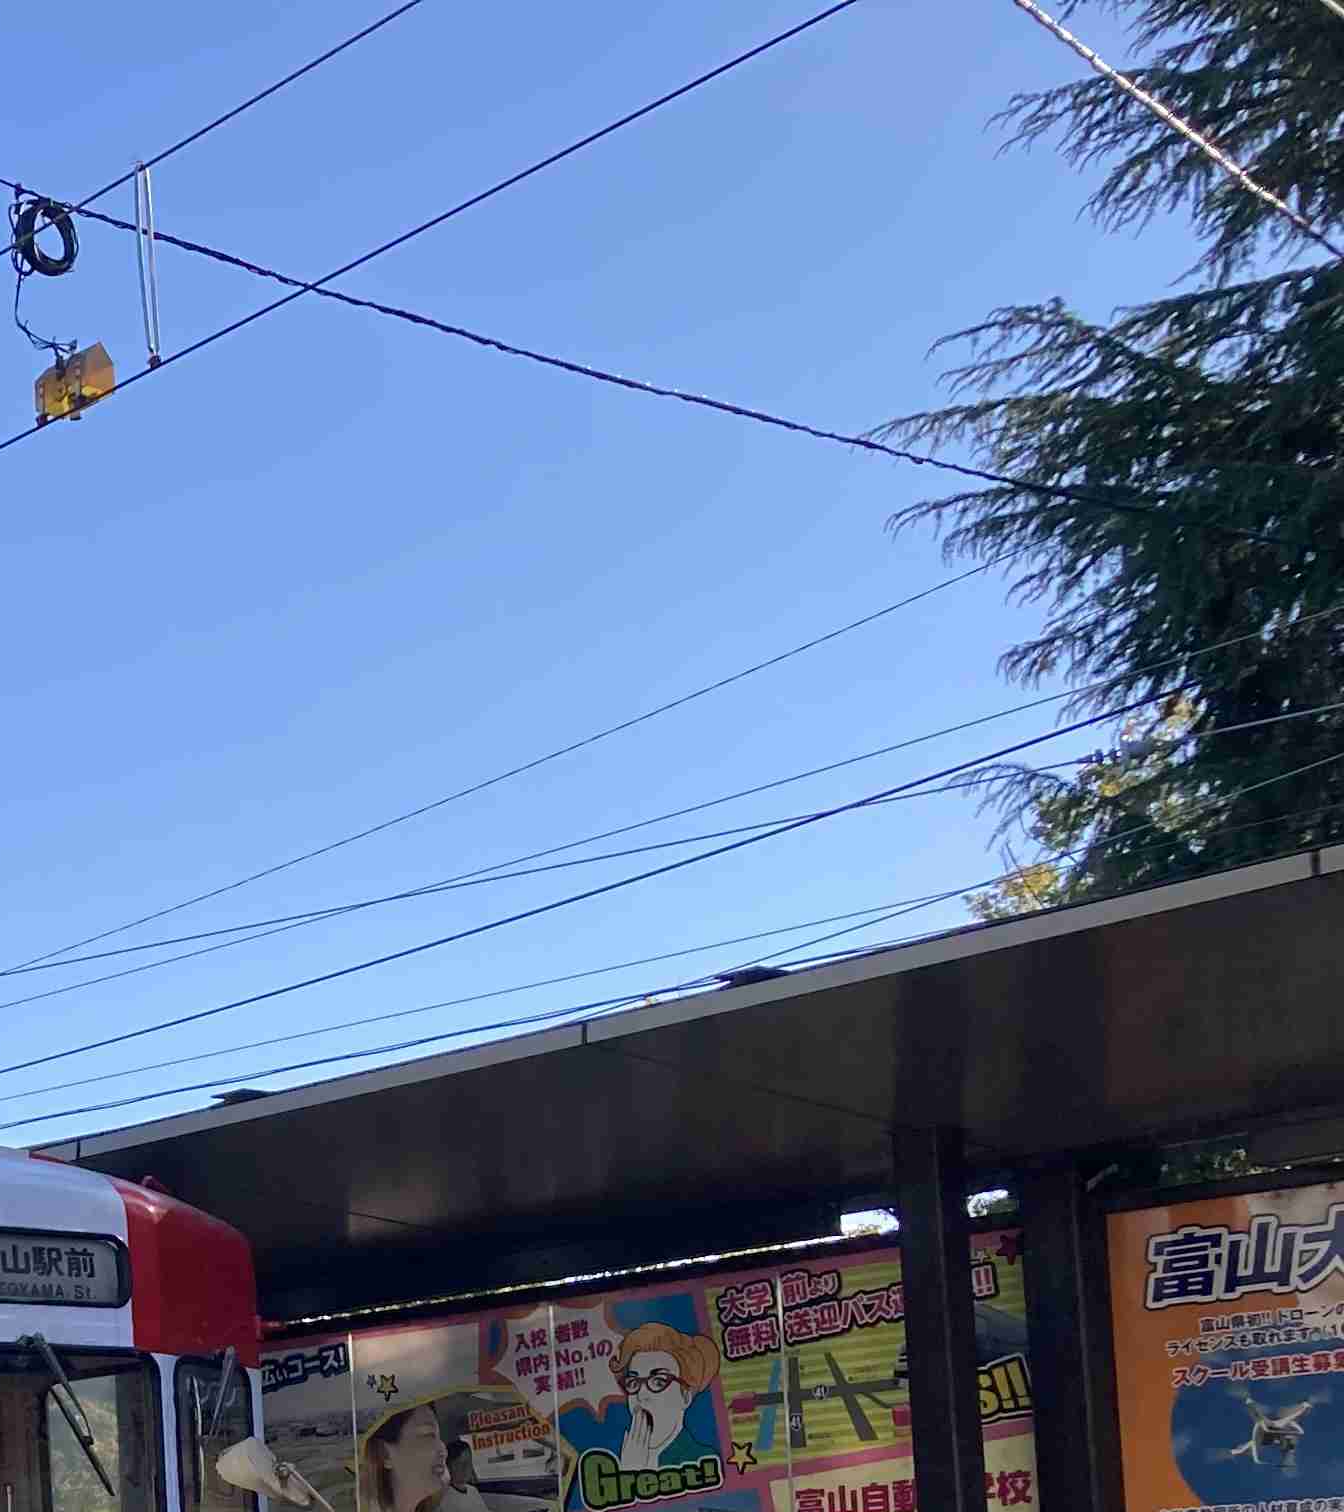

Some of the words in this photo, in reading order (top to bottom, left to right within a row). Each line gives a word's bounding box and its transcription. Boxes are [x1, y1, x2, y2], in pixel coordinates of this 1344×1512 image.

[719, 1271, 839, 1322] 大学前より
[581, 1453, 721, 1508] Great!
